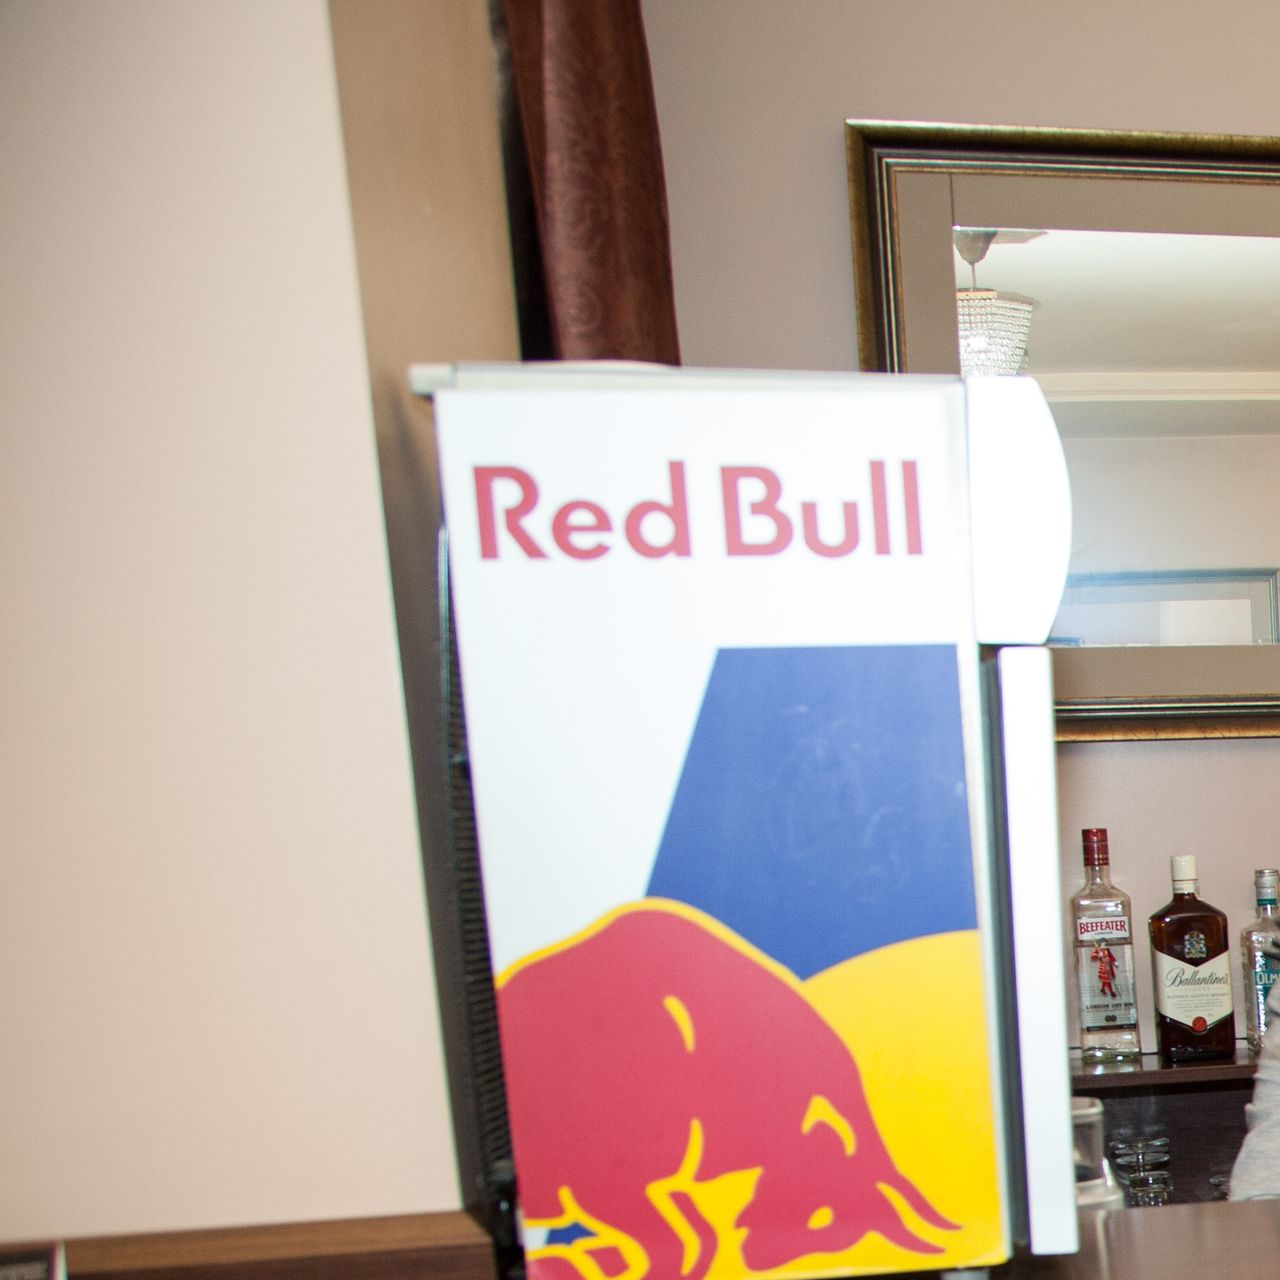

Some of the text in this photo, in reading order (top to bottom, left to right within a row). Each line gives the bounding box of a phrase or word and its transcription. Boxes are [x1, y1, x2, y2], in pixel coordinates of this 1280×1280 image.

[473, 459, 923, 560] Red Bull
[1080, 920, 1126, 934] BEEFEATER
[1166, 967, 1229, 988] Ballantine's
